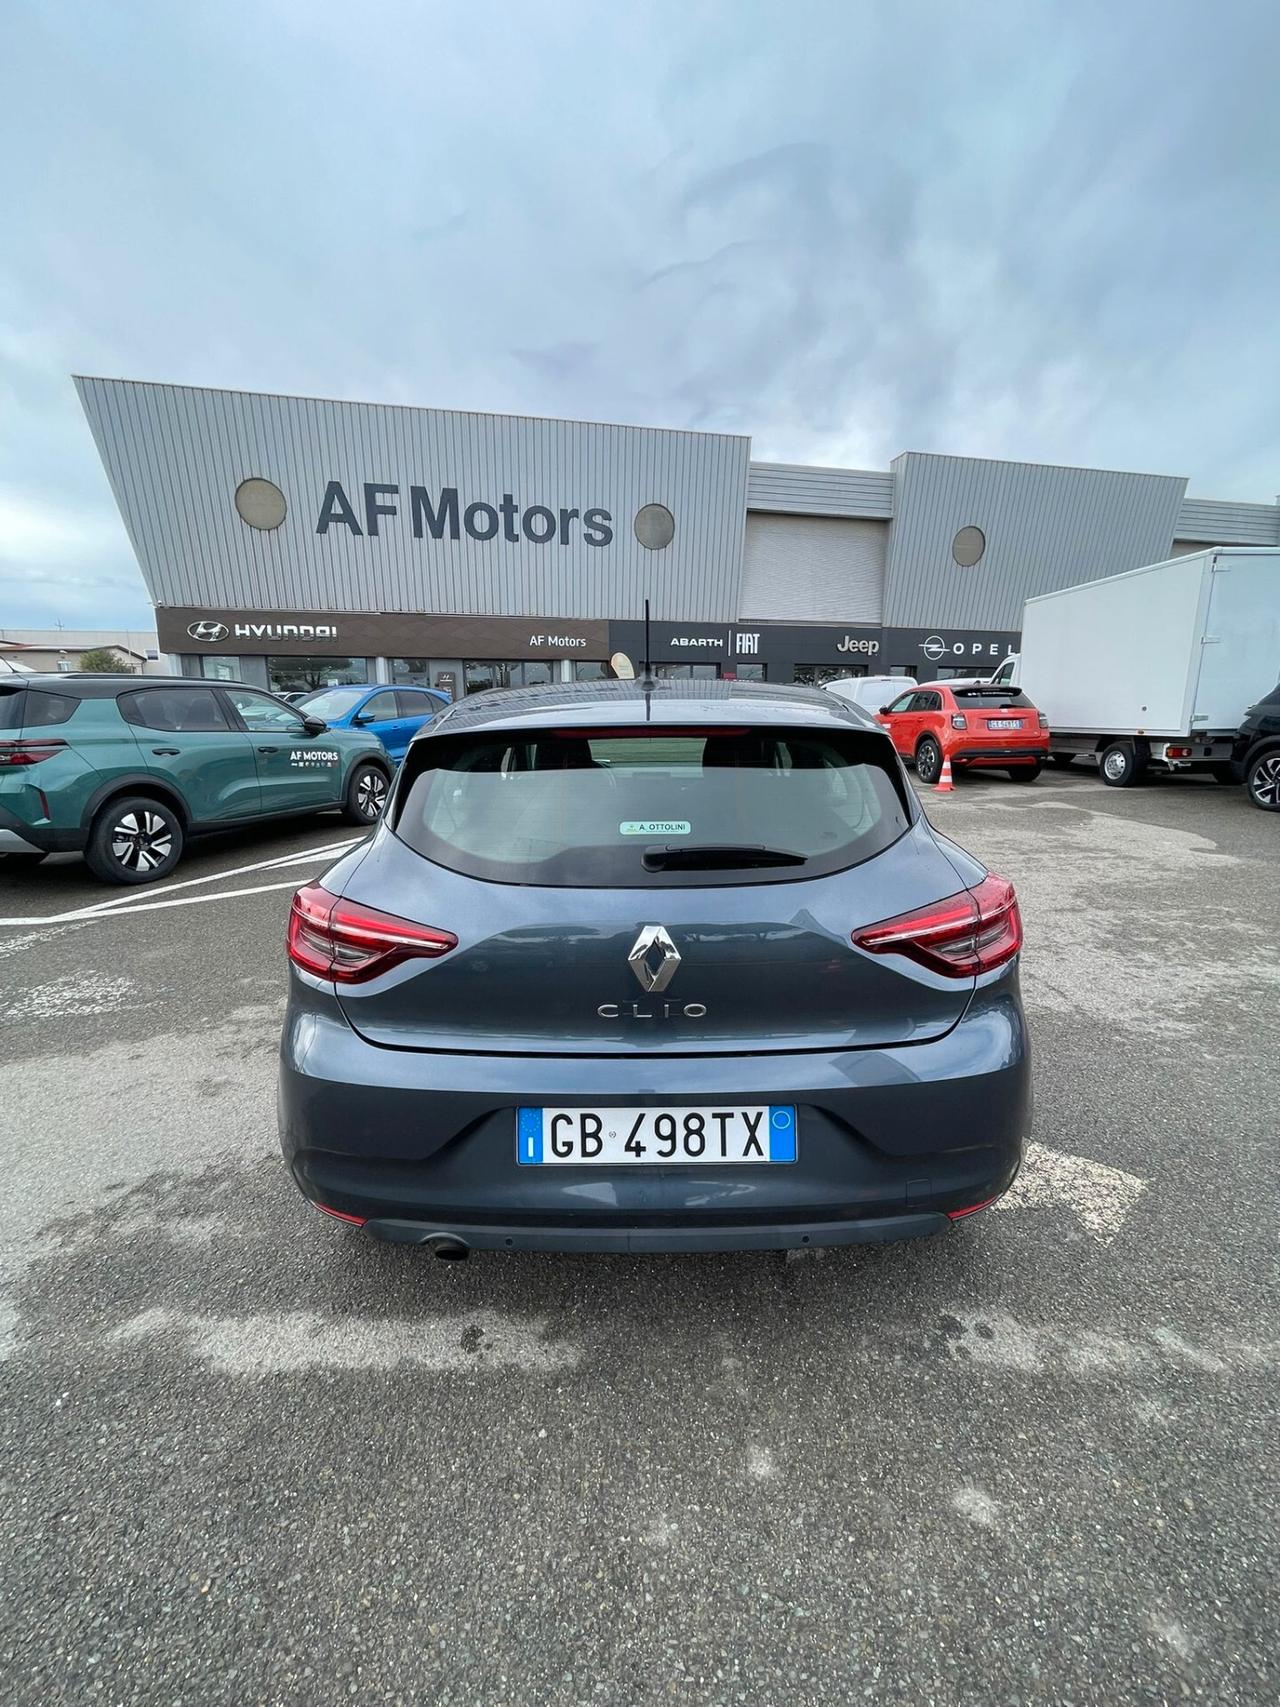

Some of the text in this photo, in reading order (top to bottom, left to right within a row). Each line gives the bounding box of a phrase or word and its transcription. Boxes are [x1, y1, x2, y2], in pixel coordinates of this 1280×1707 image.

[316, 481, 614, 547] AF Motors
[235, 624, 337, 642] HYUNDAI
[529, 635, 587, 647] AF Motors
[670, 638, 723, 647] ABARTH
[736, 633, 760, 654] FIAT
[837, 636, 879, 655] Jeep
[953, 643, 1020, 656] OPEL
[290, 751, 338, 760] AF MOTORS
[598, 1004, 707, 1018] CLIO
[551, 1112, 764, 1158] GB 498TX
